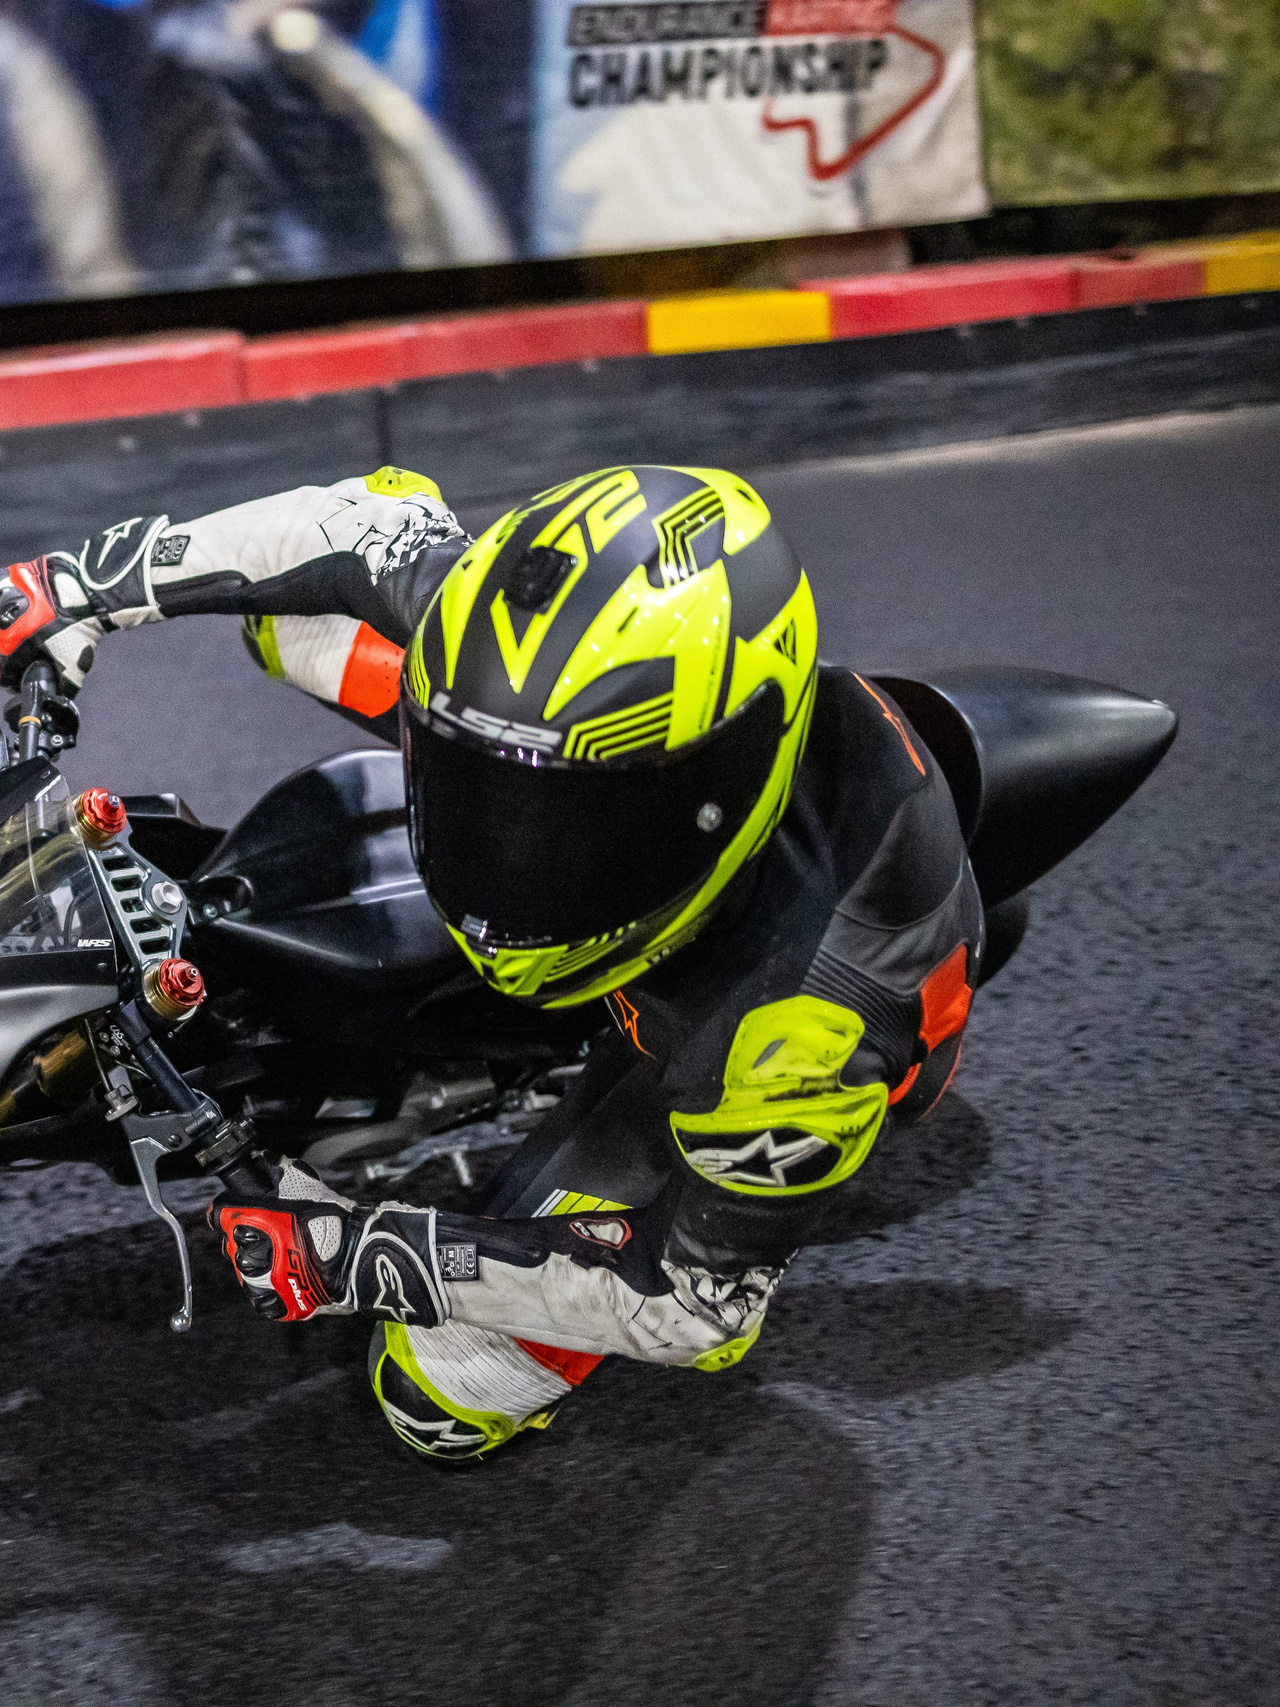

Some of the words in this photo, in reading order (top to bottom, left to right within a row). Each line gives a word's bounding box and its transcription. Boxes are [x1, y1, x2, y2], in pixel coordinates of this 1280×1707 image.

[570, 37, 888, 108] CHAMPIONSHIP
[430, 691, 563, 753] LS2
[77, 939, 112, 947] WRS
[287, 1278, 308, 1311] plus
